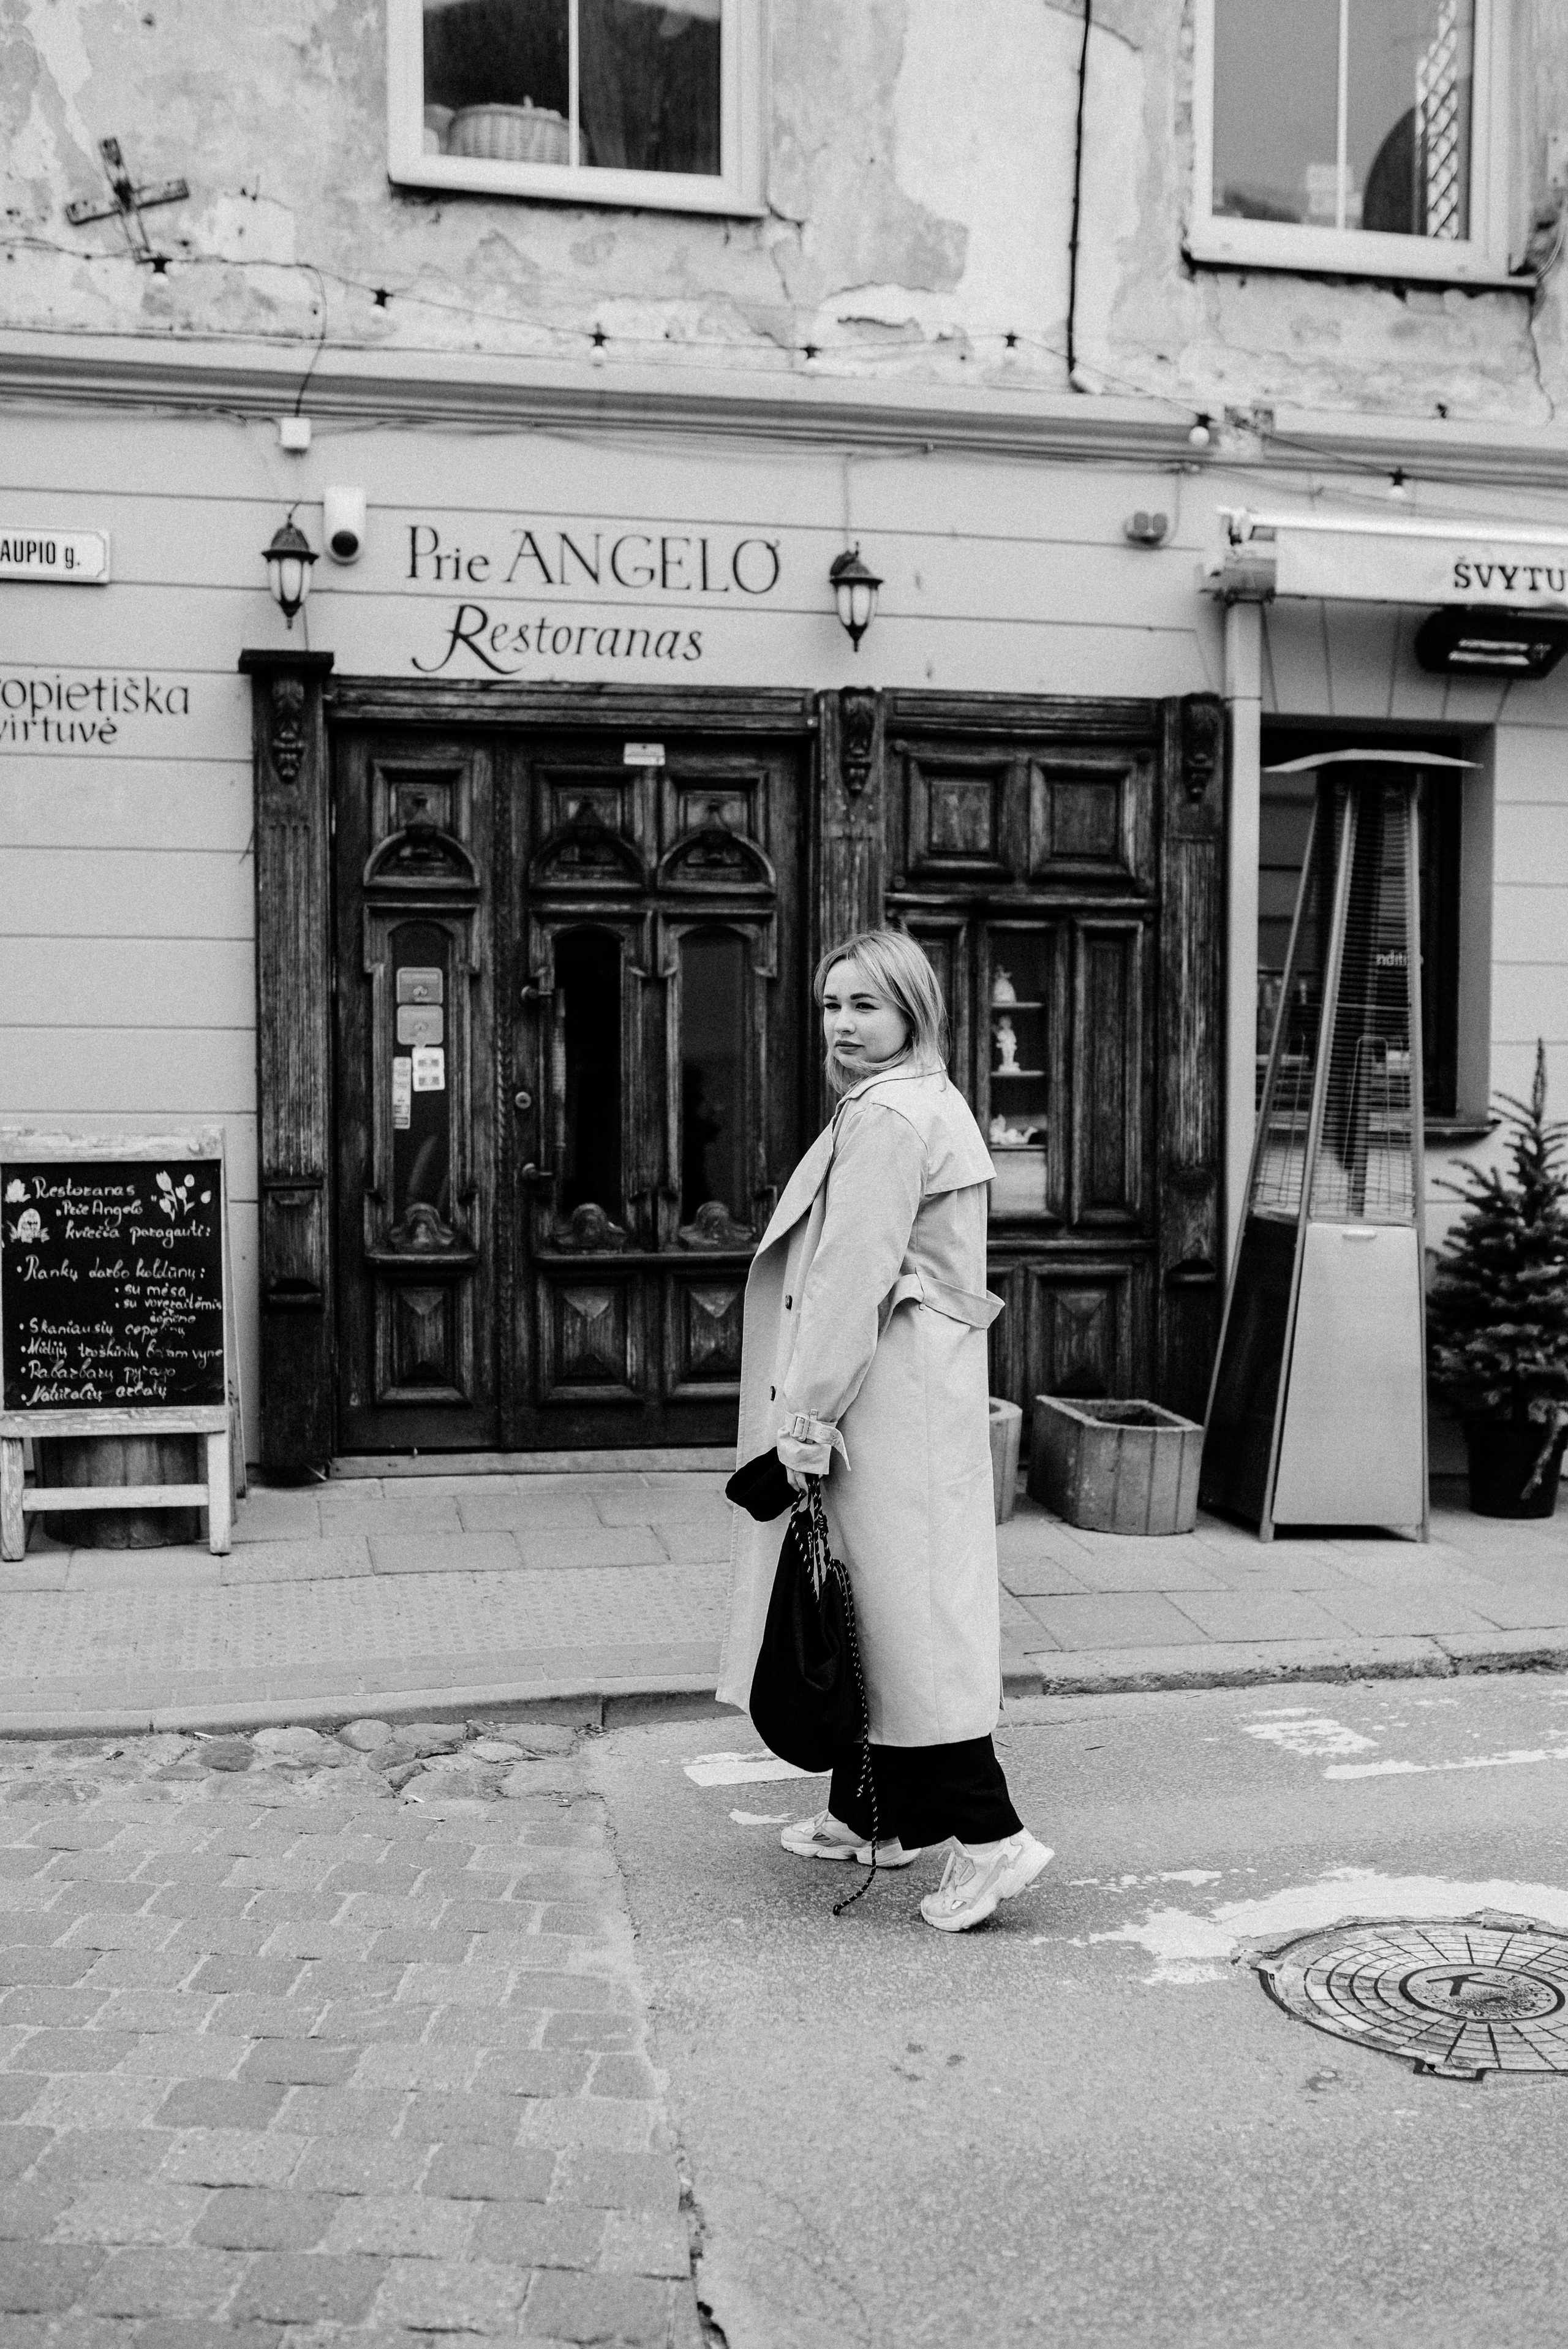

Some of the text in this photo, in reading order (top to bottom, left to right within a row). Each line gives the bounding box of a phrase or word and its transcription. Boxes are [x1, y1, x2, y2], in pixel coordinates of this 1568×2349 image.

[65, 548, 80, 569] g.
[406, 524, 781, 594] Prie ANGELO
[411, 603, 704, 675] Restoranas
[0, 675, 189, 717] opietiška
[32, 1176, 135, 1199] Restoranas
[124, 1284, 141, 1295] su
